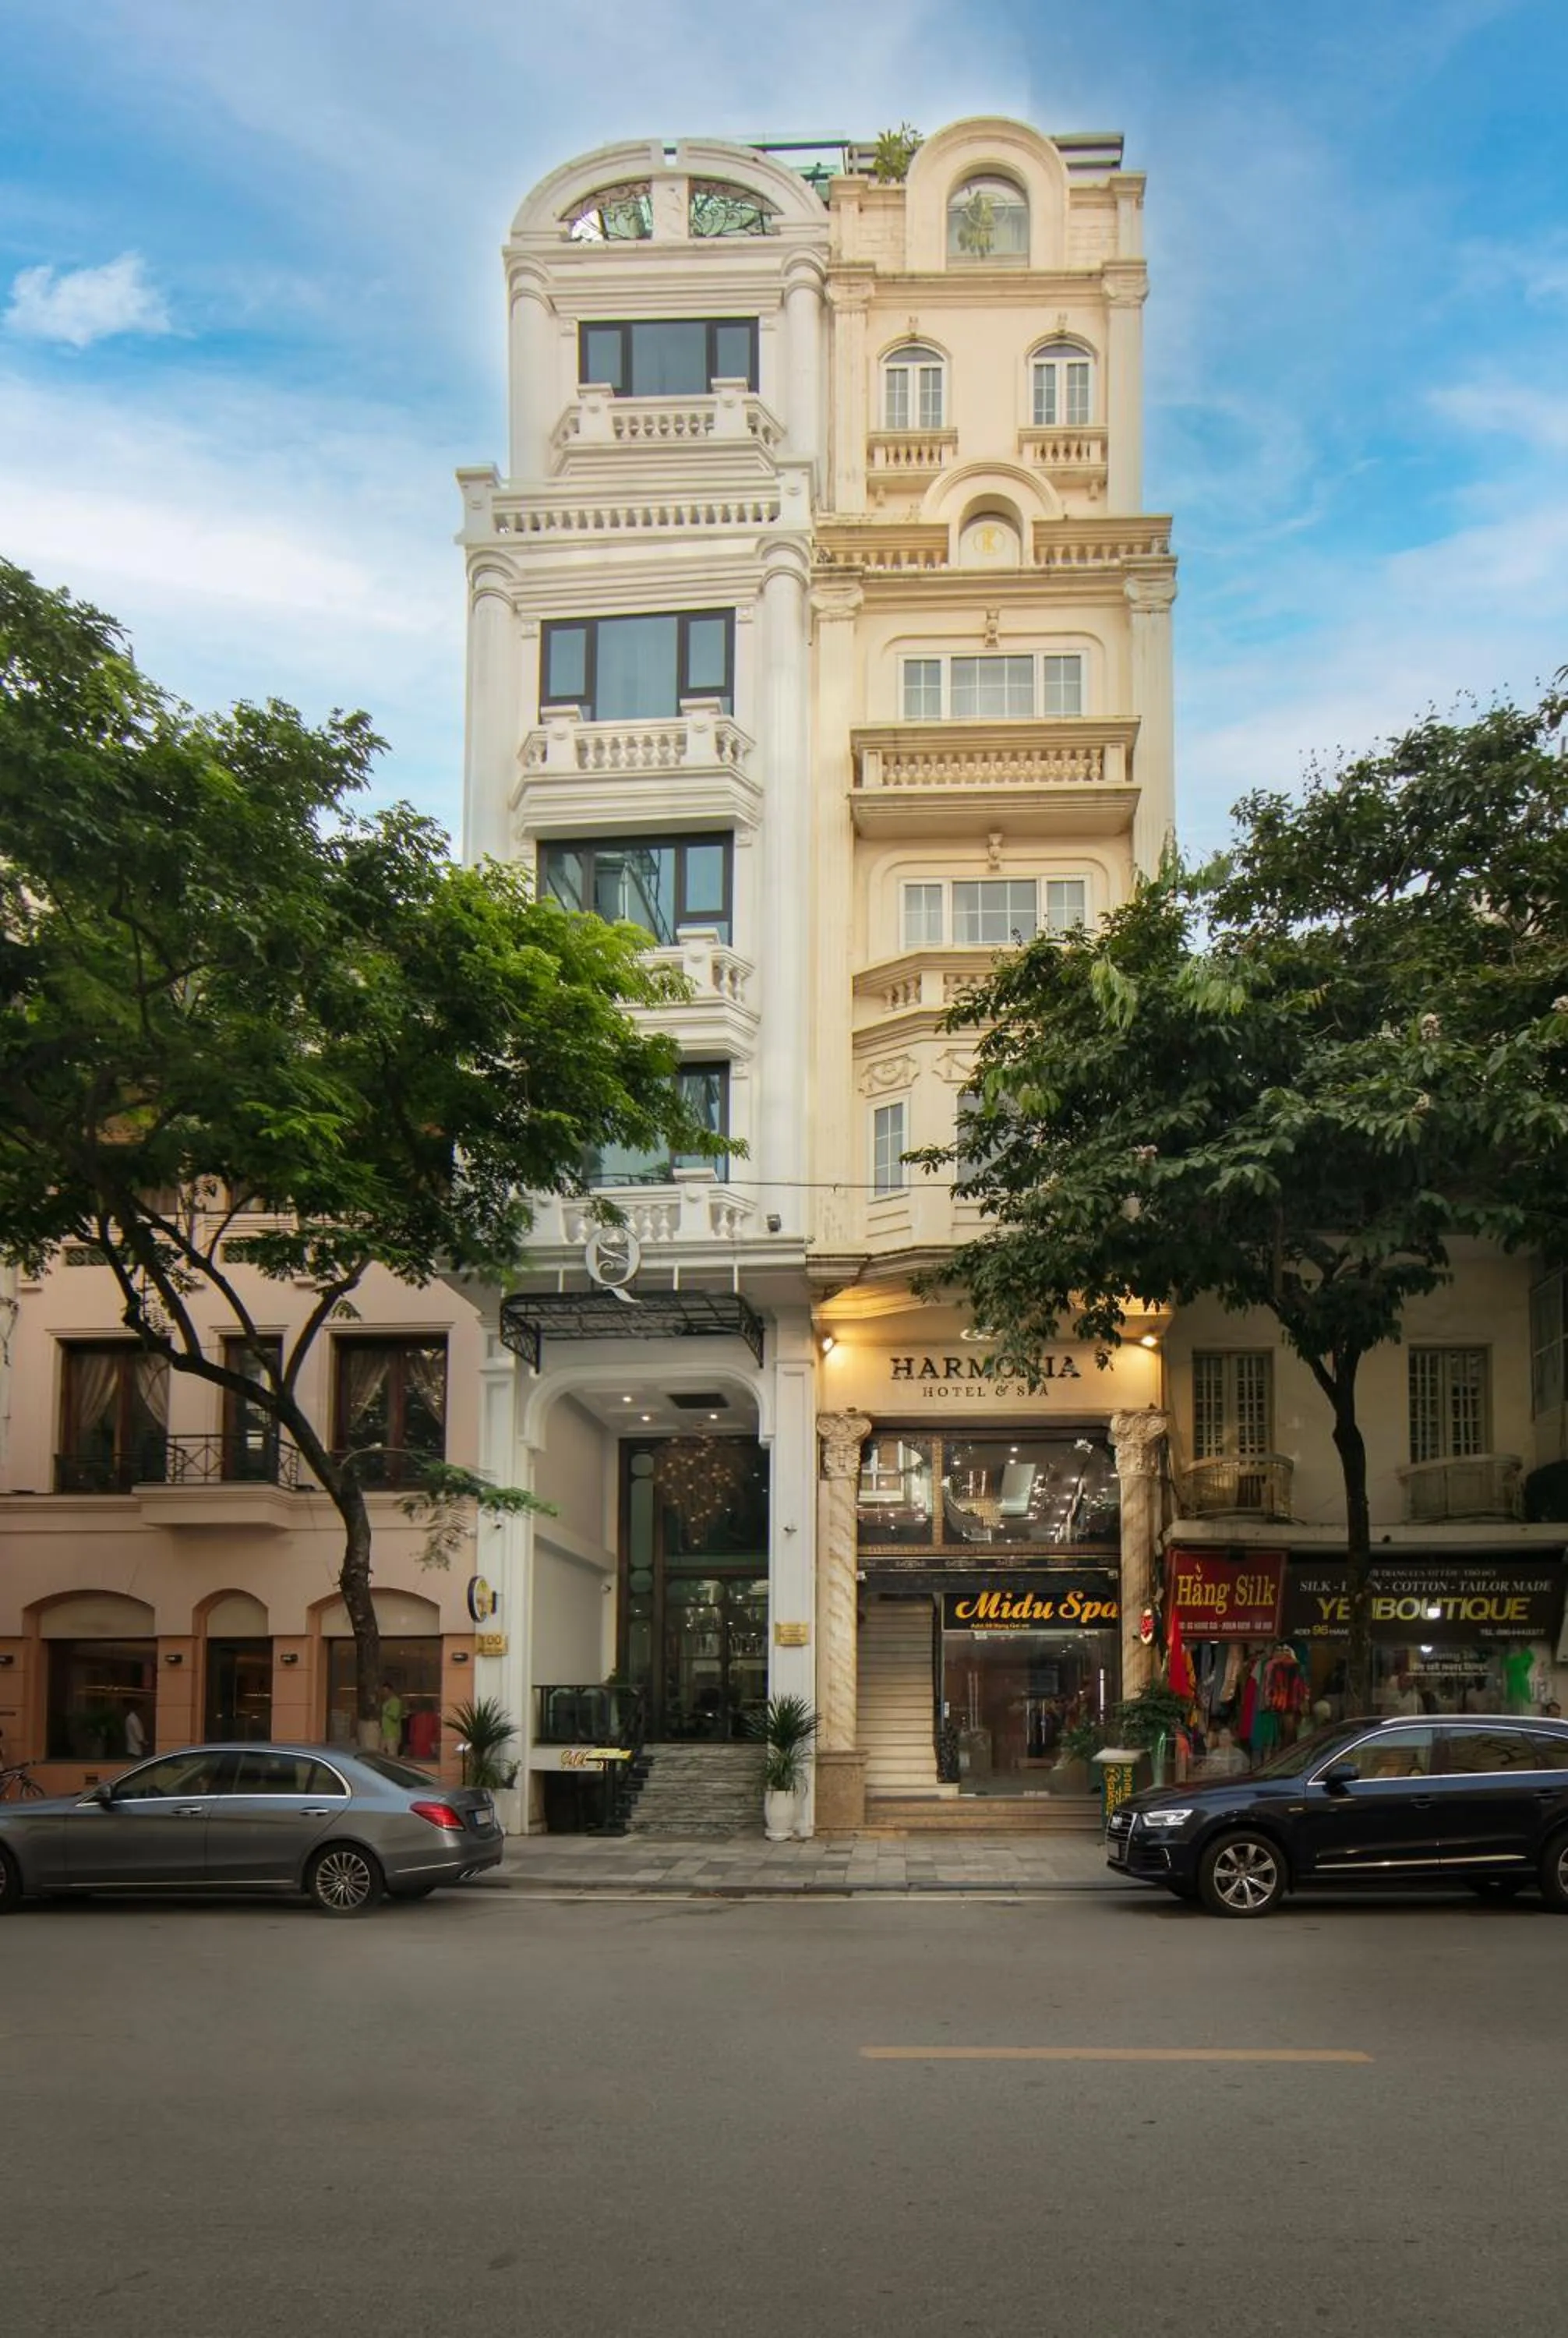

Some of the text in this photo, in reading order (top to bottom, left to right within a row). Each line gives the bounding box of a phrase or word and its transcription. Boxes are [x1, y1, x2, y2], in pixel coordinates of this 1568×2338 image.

[890, 1357, 1082, 1379] HARMONIA
[923, 1386, 986, 1397] HOTEL
[995, 1385, 1008, 1397] &
[1235, 1574, 1277, 1606] Silk
[1299, 1580, 1332, 1591] SILK
[1392, 1580, 1448, 1591] COTTON
[1459, 1580, 1510, 1591] TAILOR
[1511, 1580, 1552, 1591] MADE
[955, 1591, 1118, 1623] Midu Spa
